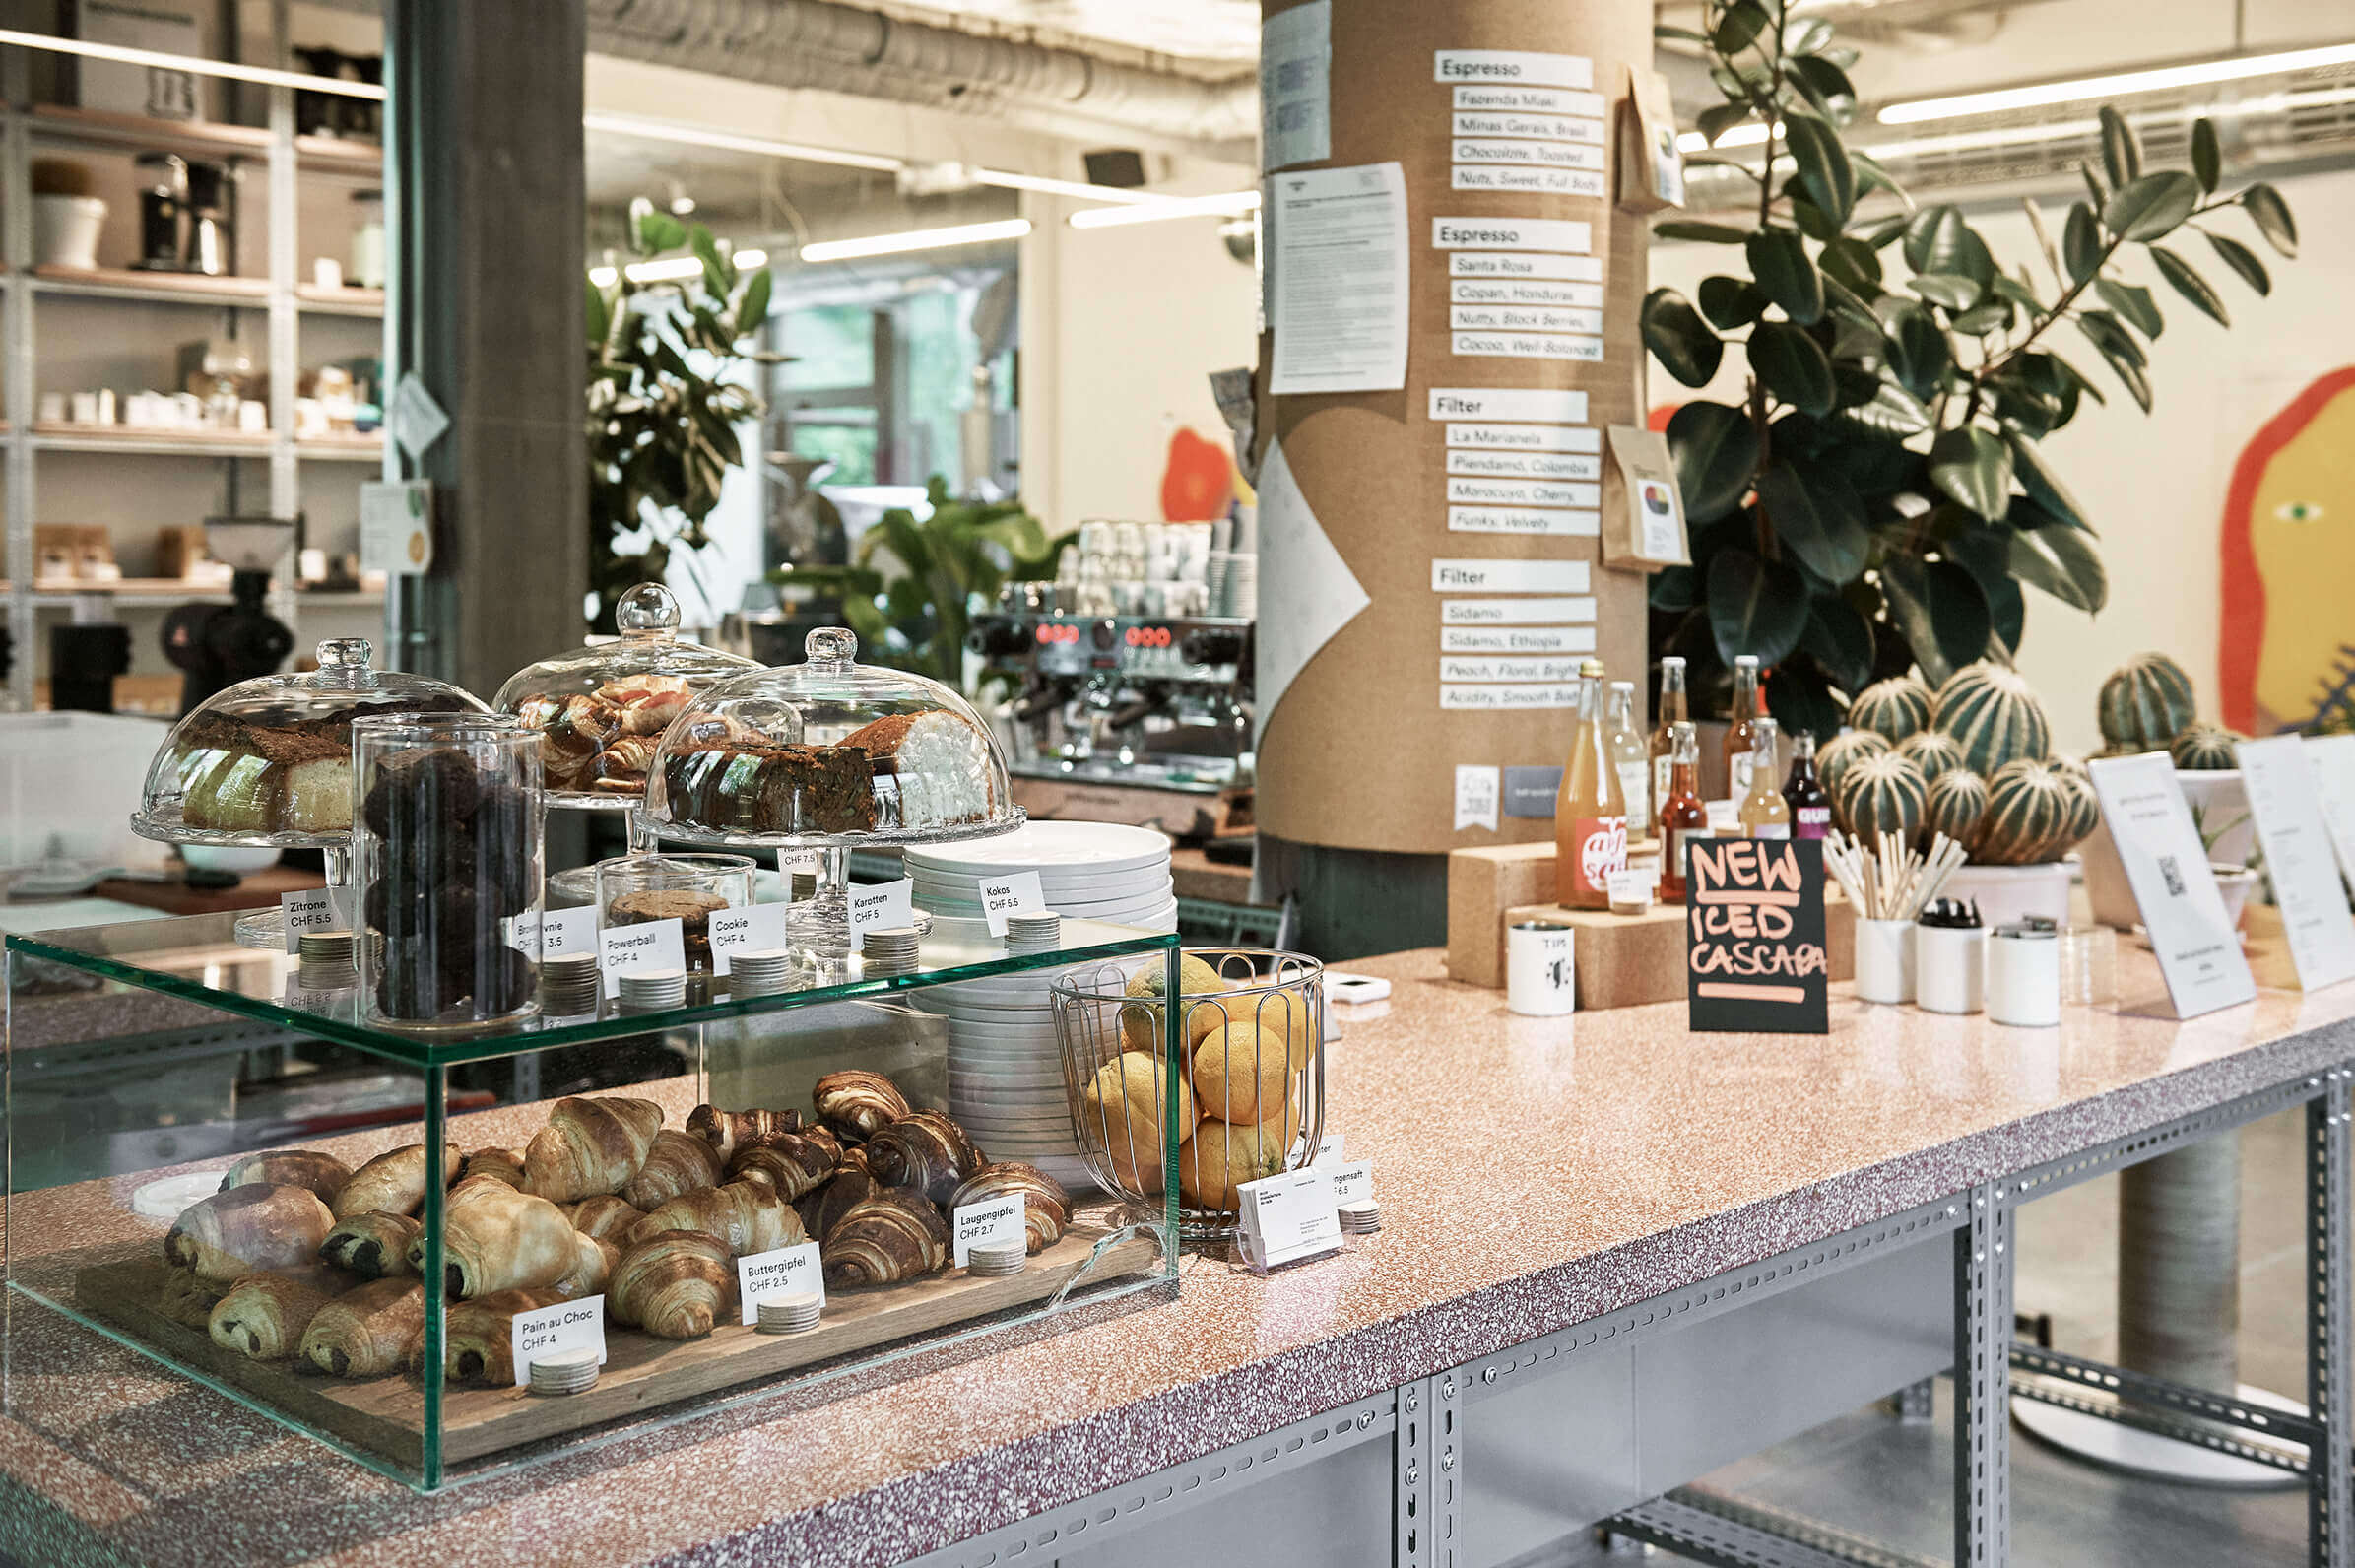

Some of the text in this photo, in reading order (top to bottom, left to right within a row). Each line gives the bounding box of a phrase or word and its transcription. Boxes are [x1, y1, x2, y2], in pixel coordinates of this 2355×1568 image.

[1441, 59, 1521, 78] Espresso
[1459, 91, 1518, 106] Fazenda
[1459, 117, 1502, 132] Minas
[1458, 144, 1531, 161] Chocolate,
[1458, 170, 1494, 186] Nuts,
[1499, 171, 1542, 187] Sweet,
[1546, 173, 1568, 188] Full
[1440, 226, 1520, 243] Espresso
[1457, 258, 1534, 273] Santa Rosa
[1512, 287, 1574, 301] Honduras
[1458, 312, 1496, 327] Nutty,
[1502, 311, 1537, 325] Black
[1458, 337, 1506, 352] Cocoa,
[1436, 397, 1483, 414] Filter
[1453, 429, 1471, 443] La
[1532, 458, 1590, 475] Colombia
[1455, 512, 1497, 528] Funky,
[1440, 567, 1486, 585] Filter
[1448, 606, 1503, 620] Sidamo
[1448, 633, 1563, 650] Sidamo, Ethiopia
[1447, 662, 1493, 679] Peach,
[1502, 689, 1551, 704] Smooth
[784, 854, 816, 866] CHF 7.5
[1691, 841, 1802, 892] NEW
[986, 886, 1011, 897] Kokos
[289, 900, 327, 913] Zitrone
[853, 893, 888, 909] Karotten
[989, 897, 1019, 911] CHF 5.5
[291, 913, 332, 927] CHF 5.5
[715, 917, 749, 932] Cookie
[854, 911, 880, 924] CHF 5
[1691, 903, 1794, 943] ICED
[548, 936, 563, 948] 3.5
[607, 933, 657, 951] Powerball
[716, 934, 746, 947] CHF 4
[608, 953, 638, 967] CHF 4
[1333, 1169, 1363, 1184] ngensaft
[1338, 1185, 1348, 1196] 6.5
[959, 1204, 1016, 1228] Laugengipfel
[959, 1223, 995, 1241] CHF 2.7
[747, 1255, 807, 1278] Buttergipfel
[749, 1274, 789, 1294] CHF 2.5
[522, 1308, 594, 1335] Pain au Choc
[522, 1333, 557, 1352] CHF 4
